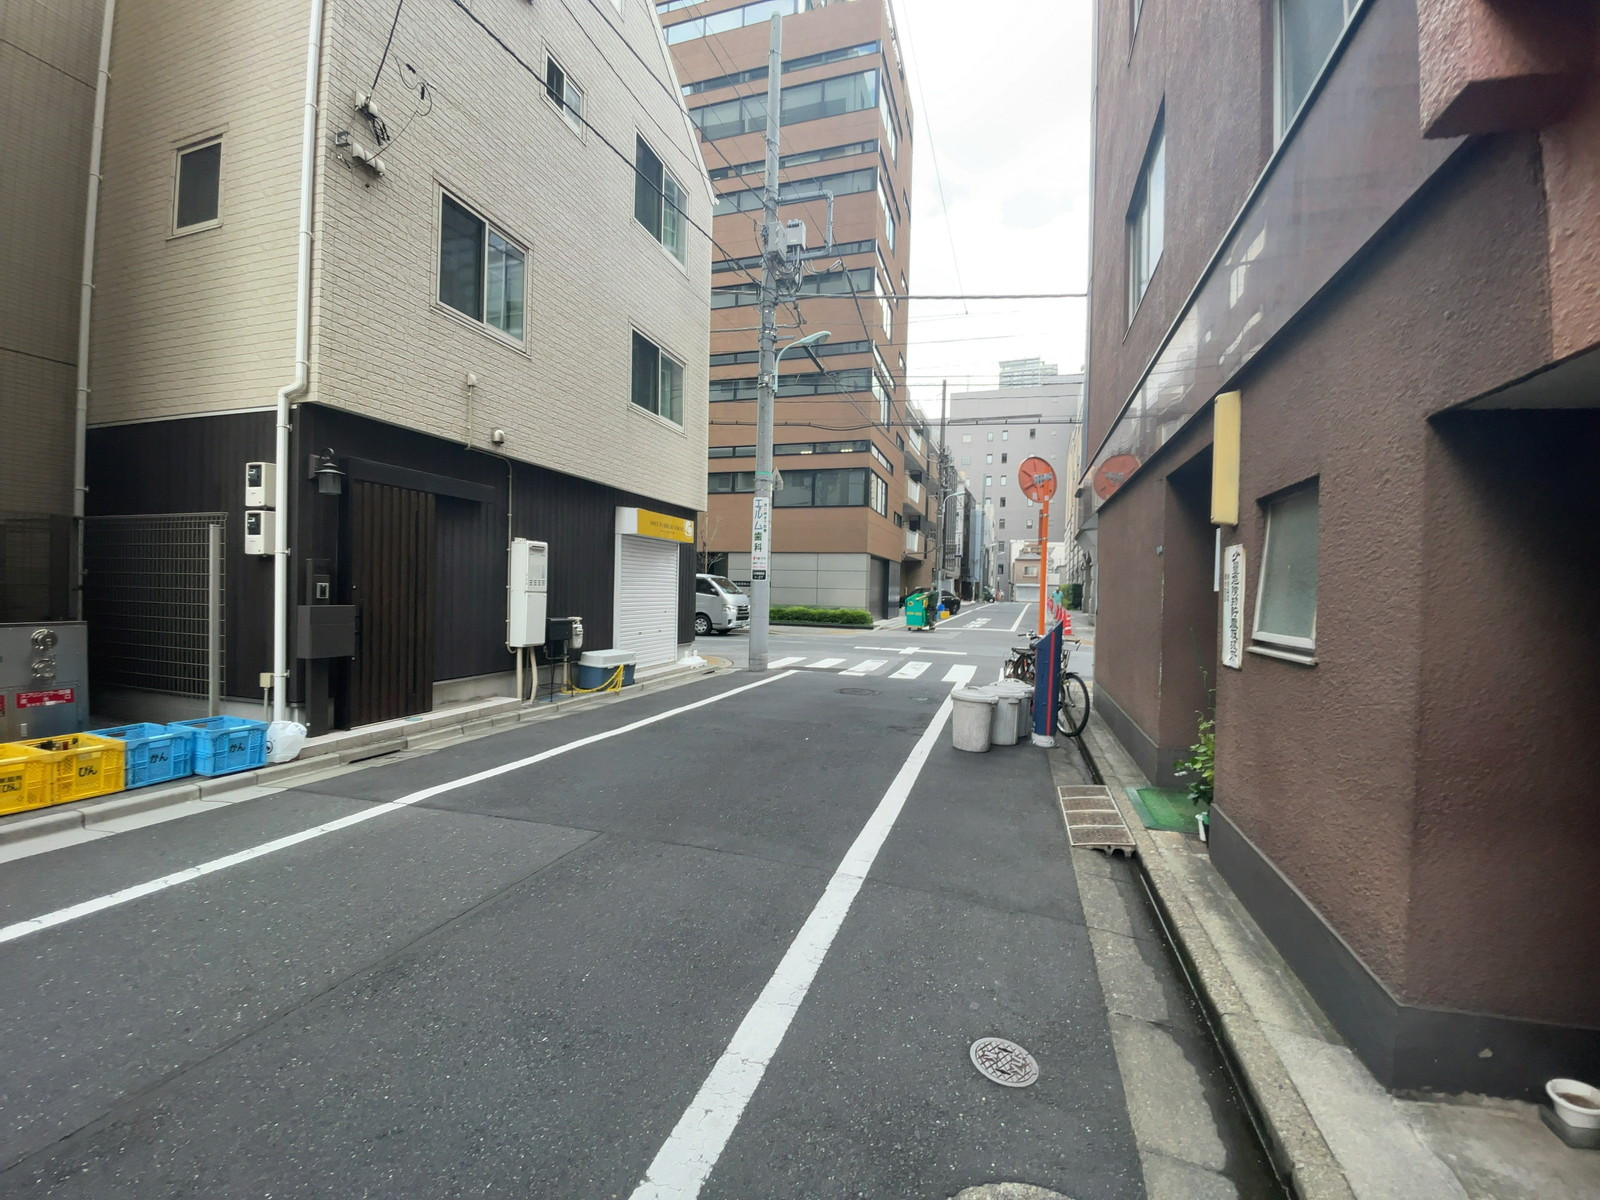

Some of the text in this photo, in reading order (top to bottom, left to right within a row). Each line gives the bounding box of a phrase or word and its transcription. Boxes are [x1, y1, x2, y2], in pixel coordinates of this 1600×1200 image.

[754, 499, 764, 552] エルム歯科
[229, 743, 246, 754] かん
[150, 752, 169, 764] かん
[78, 765, 98, 777] びん
